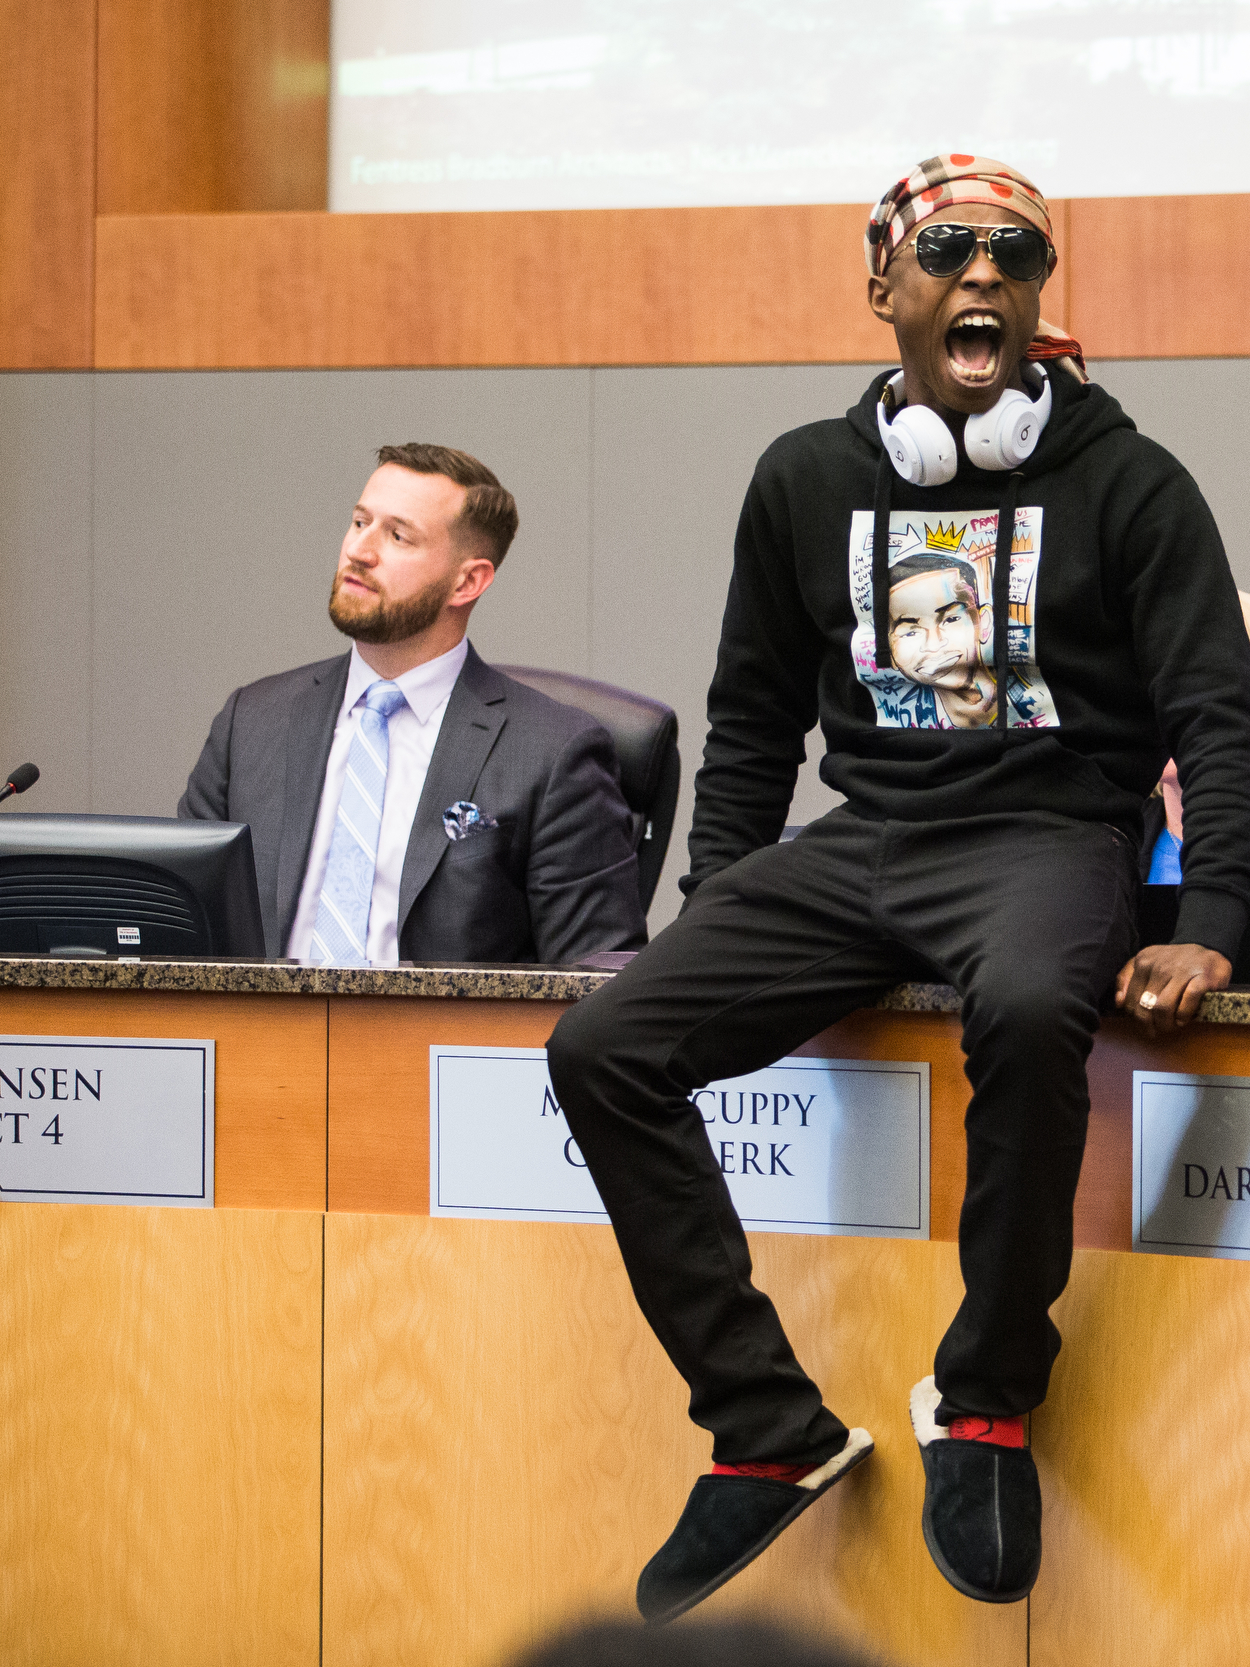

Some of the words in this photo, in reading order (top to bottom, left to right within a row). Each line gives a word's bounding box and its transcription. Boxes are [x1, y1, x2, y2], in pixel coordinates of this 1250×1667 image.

[692, 1090, 818, 1127] CUPPY
[0, 1112, 29, 1145] T
[41, 1114, 64, 1145] 4
[718, 1141, 796, 1176] ERK
